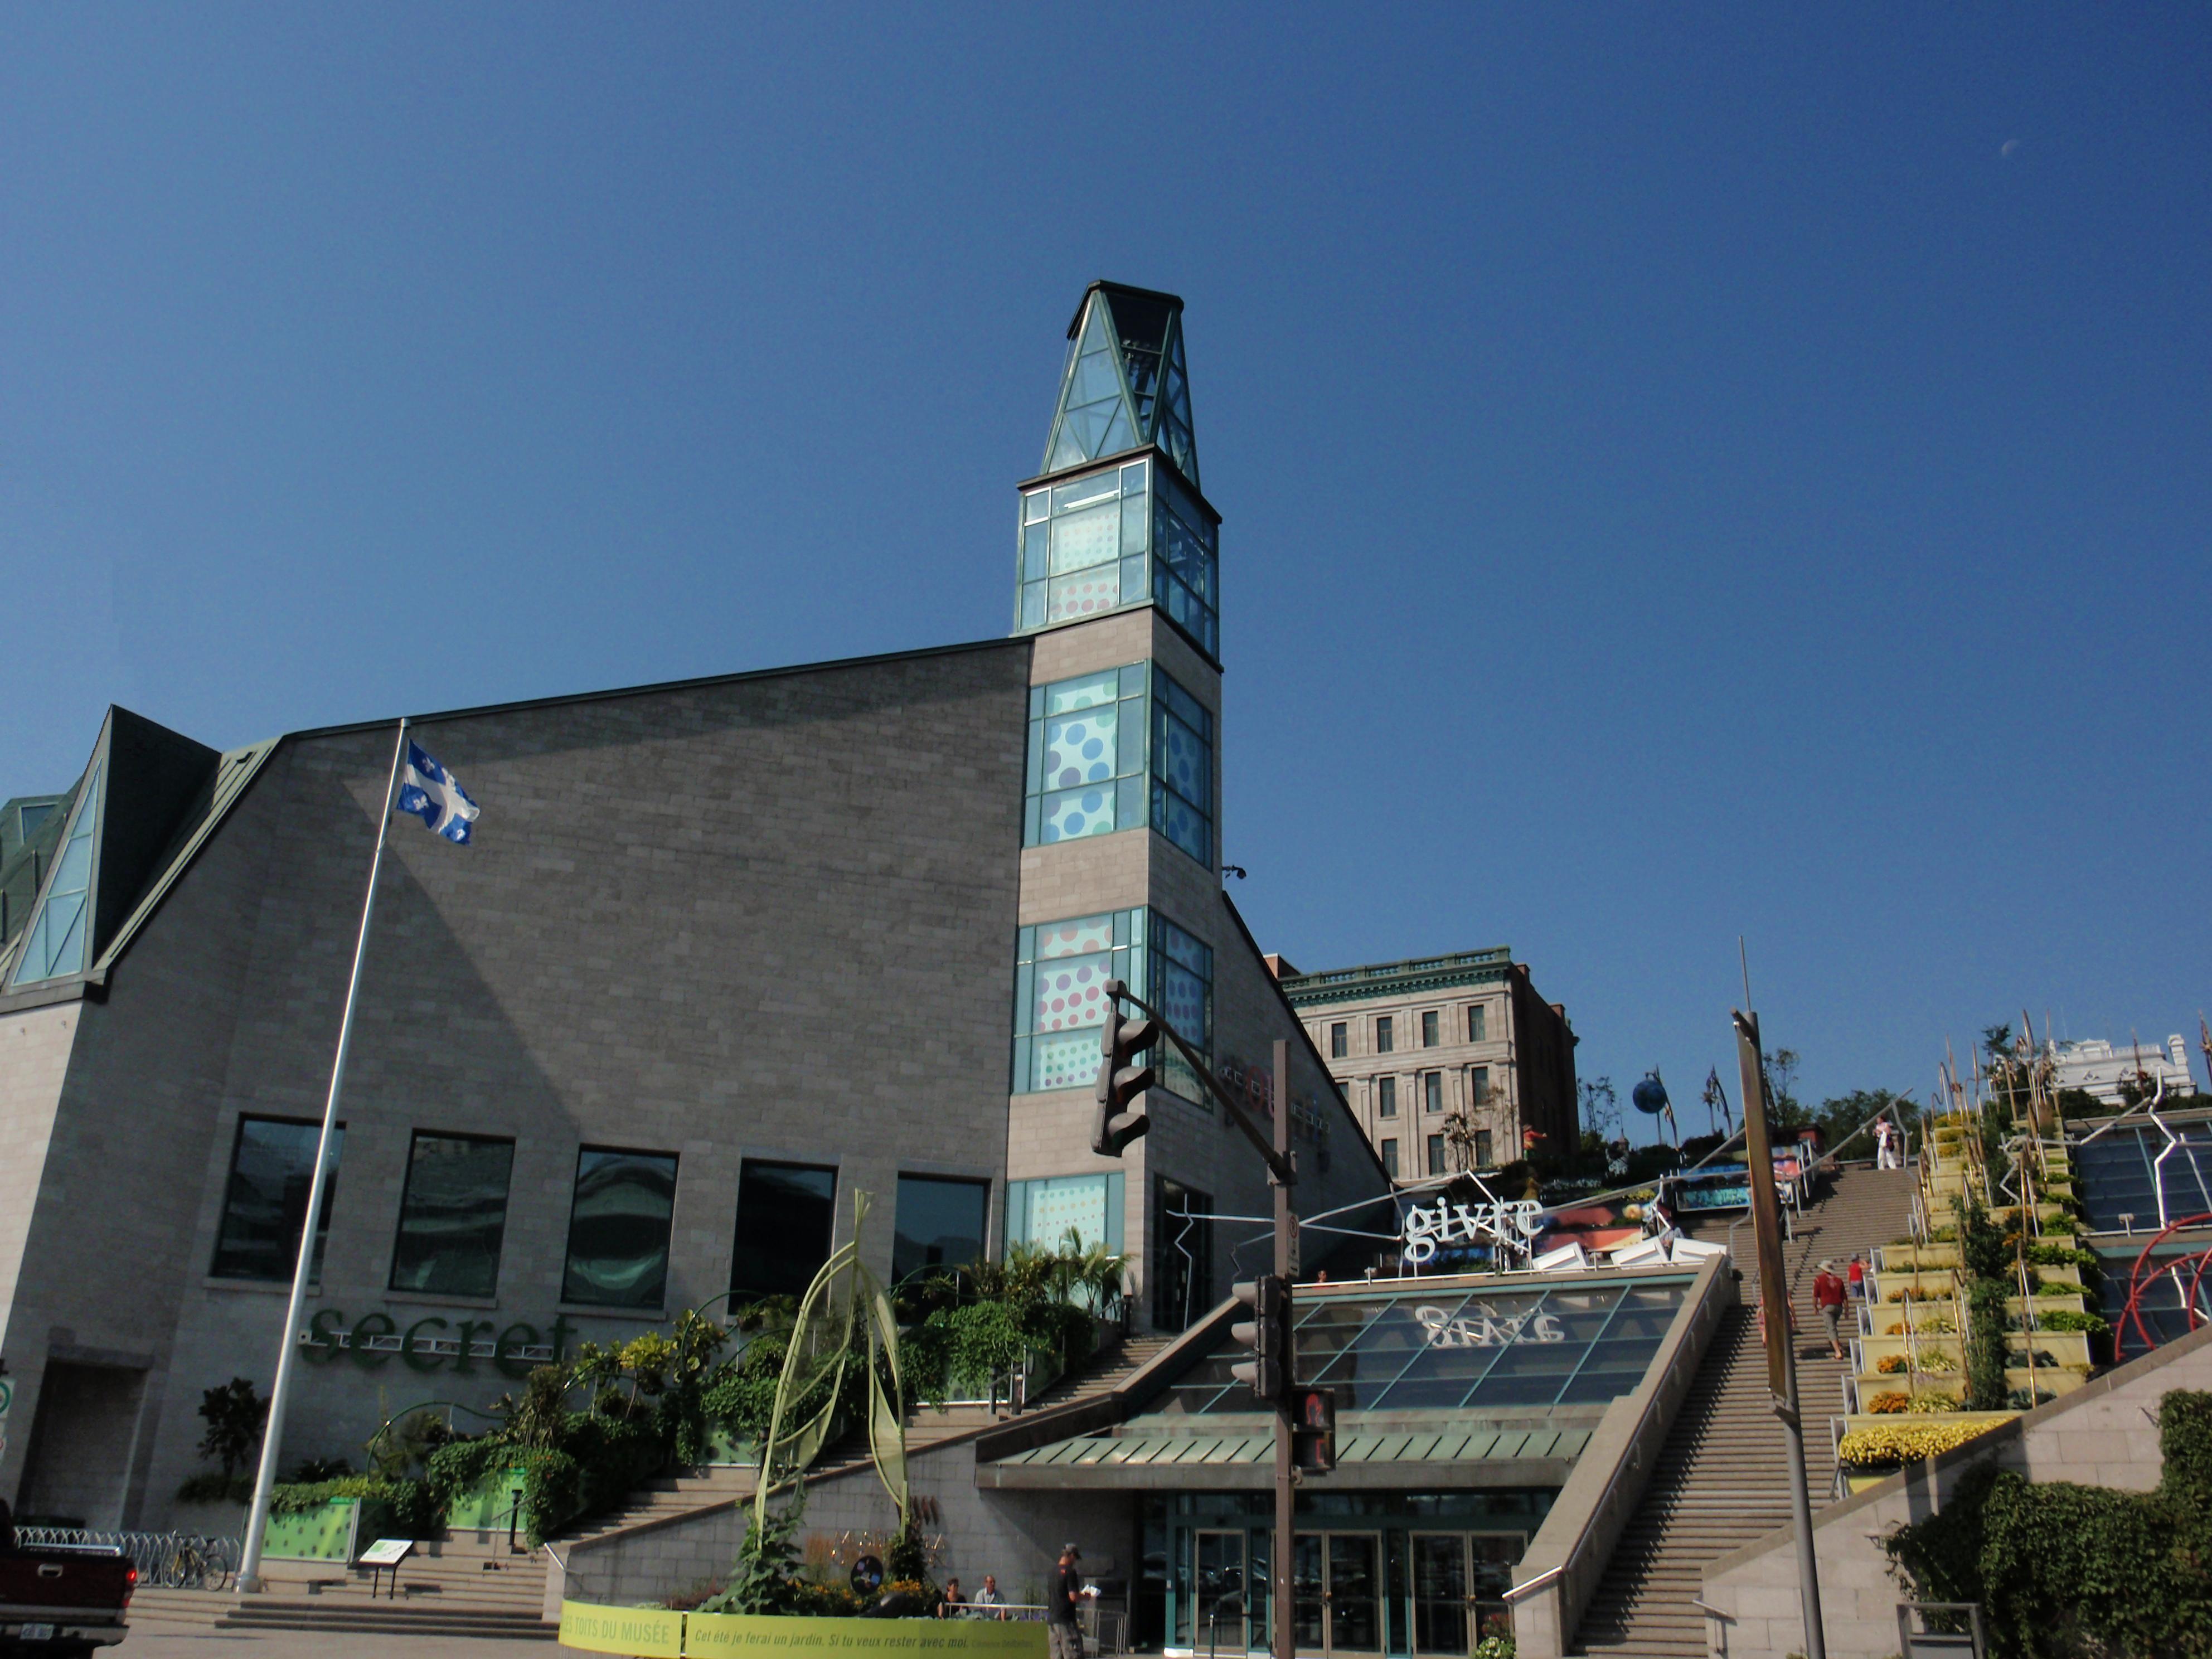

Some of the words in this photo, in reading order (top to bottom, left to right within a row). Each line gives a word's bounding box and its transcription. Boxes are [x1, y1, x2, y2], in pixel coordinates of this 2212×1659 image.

[1404, 1196, 1544, 1263] givre
[301, 1308, 578, 1379] secret
[575, 1616, 598, 1637] TOITS
[602, 1620, 617, 1639] DU
[621, 1619, 670, 1645] MUSÉE
[695, 1629, 711, 1642] Cet
[714, 1629, 729, 1643] été
[731, 1631, 743, 1646] je
[746, 1631, 772, 1645] ferai
[774, 1634, 787, 1645] un
[789, 1633, 824, 1647] jardin.
[828, 1633, 840, 1646] Si
[842, 1634, 853, 1647] tu
[857, 1637, 880, 1647] veux
[884, 1636, 918, 1648] rester
[920, 1638, 944, 1648] avec
